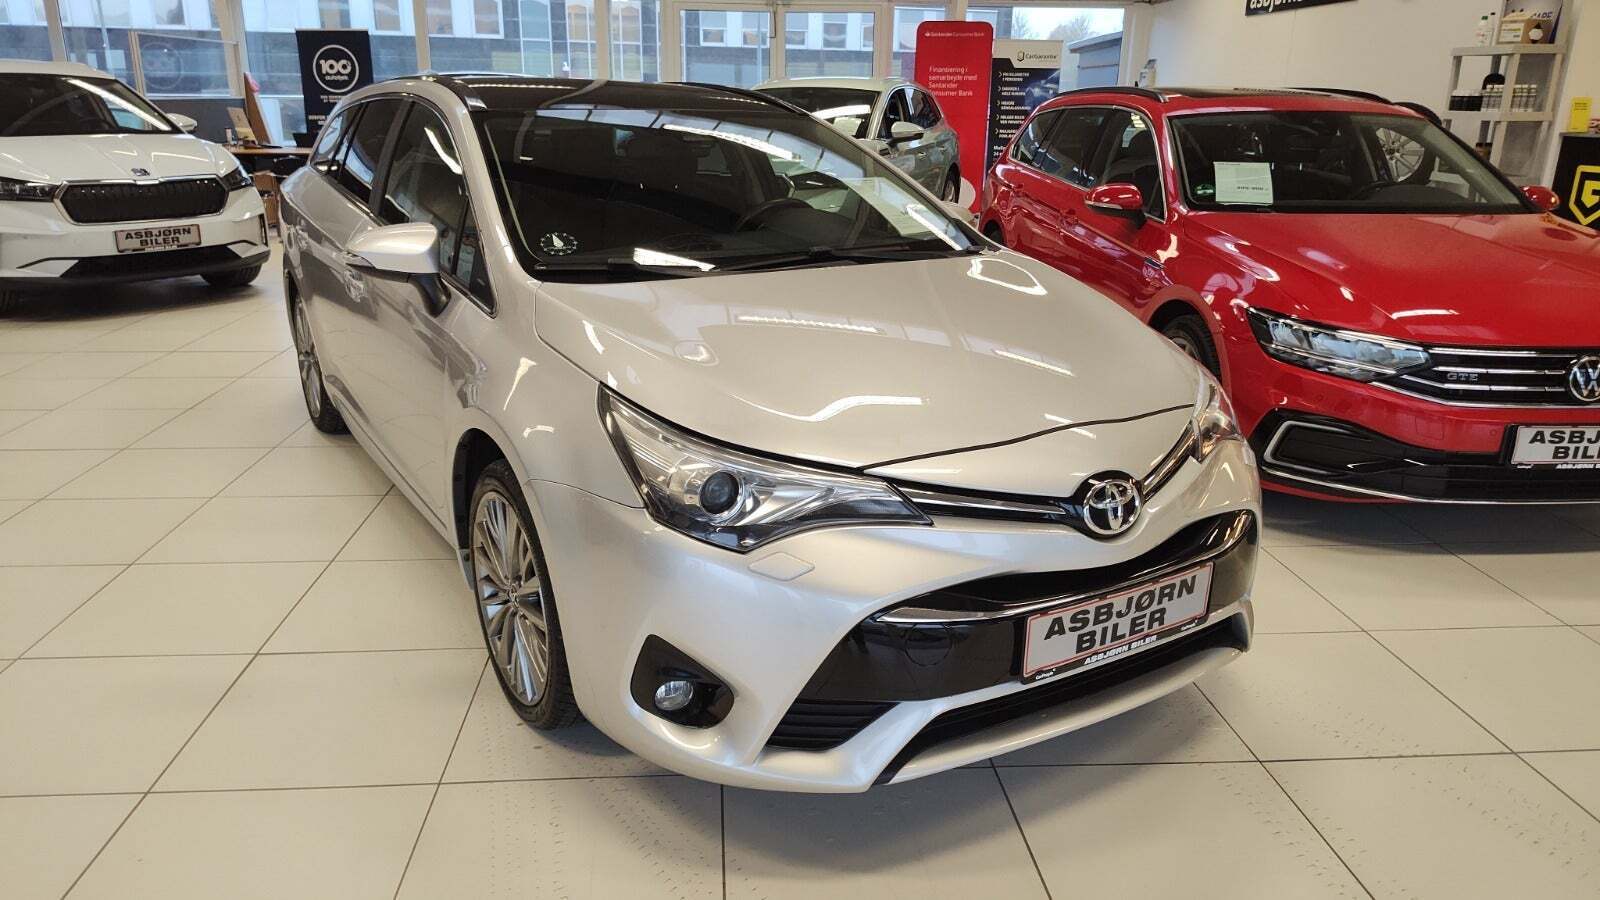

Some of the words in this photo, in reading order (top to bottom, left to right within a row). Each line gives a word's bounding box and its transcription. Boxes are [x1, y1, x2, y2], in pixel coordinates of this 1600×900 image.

[928, 81, 958, 89] Santander
[124, 227, 191, 240] ASBJØRN
[139, 236, 181, 247] BILER
[1447, 372, 1479, 382] GTE
[1044, 575, 1198, 641] ASBJØRN
[1075, 607, 1167, 655] BILER
[1083, 644, 1129, 665] ASBJØRN
[1130, 635, 1158, 651] BILER
